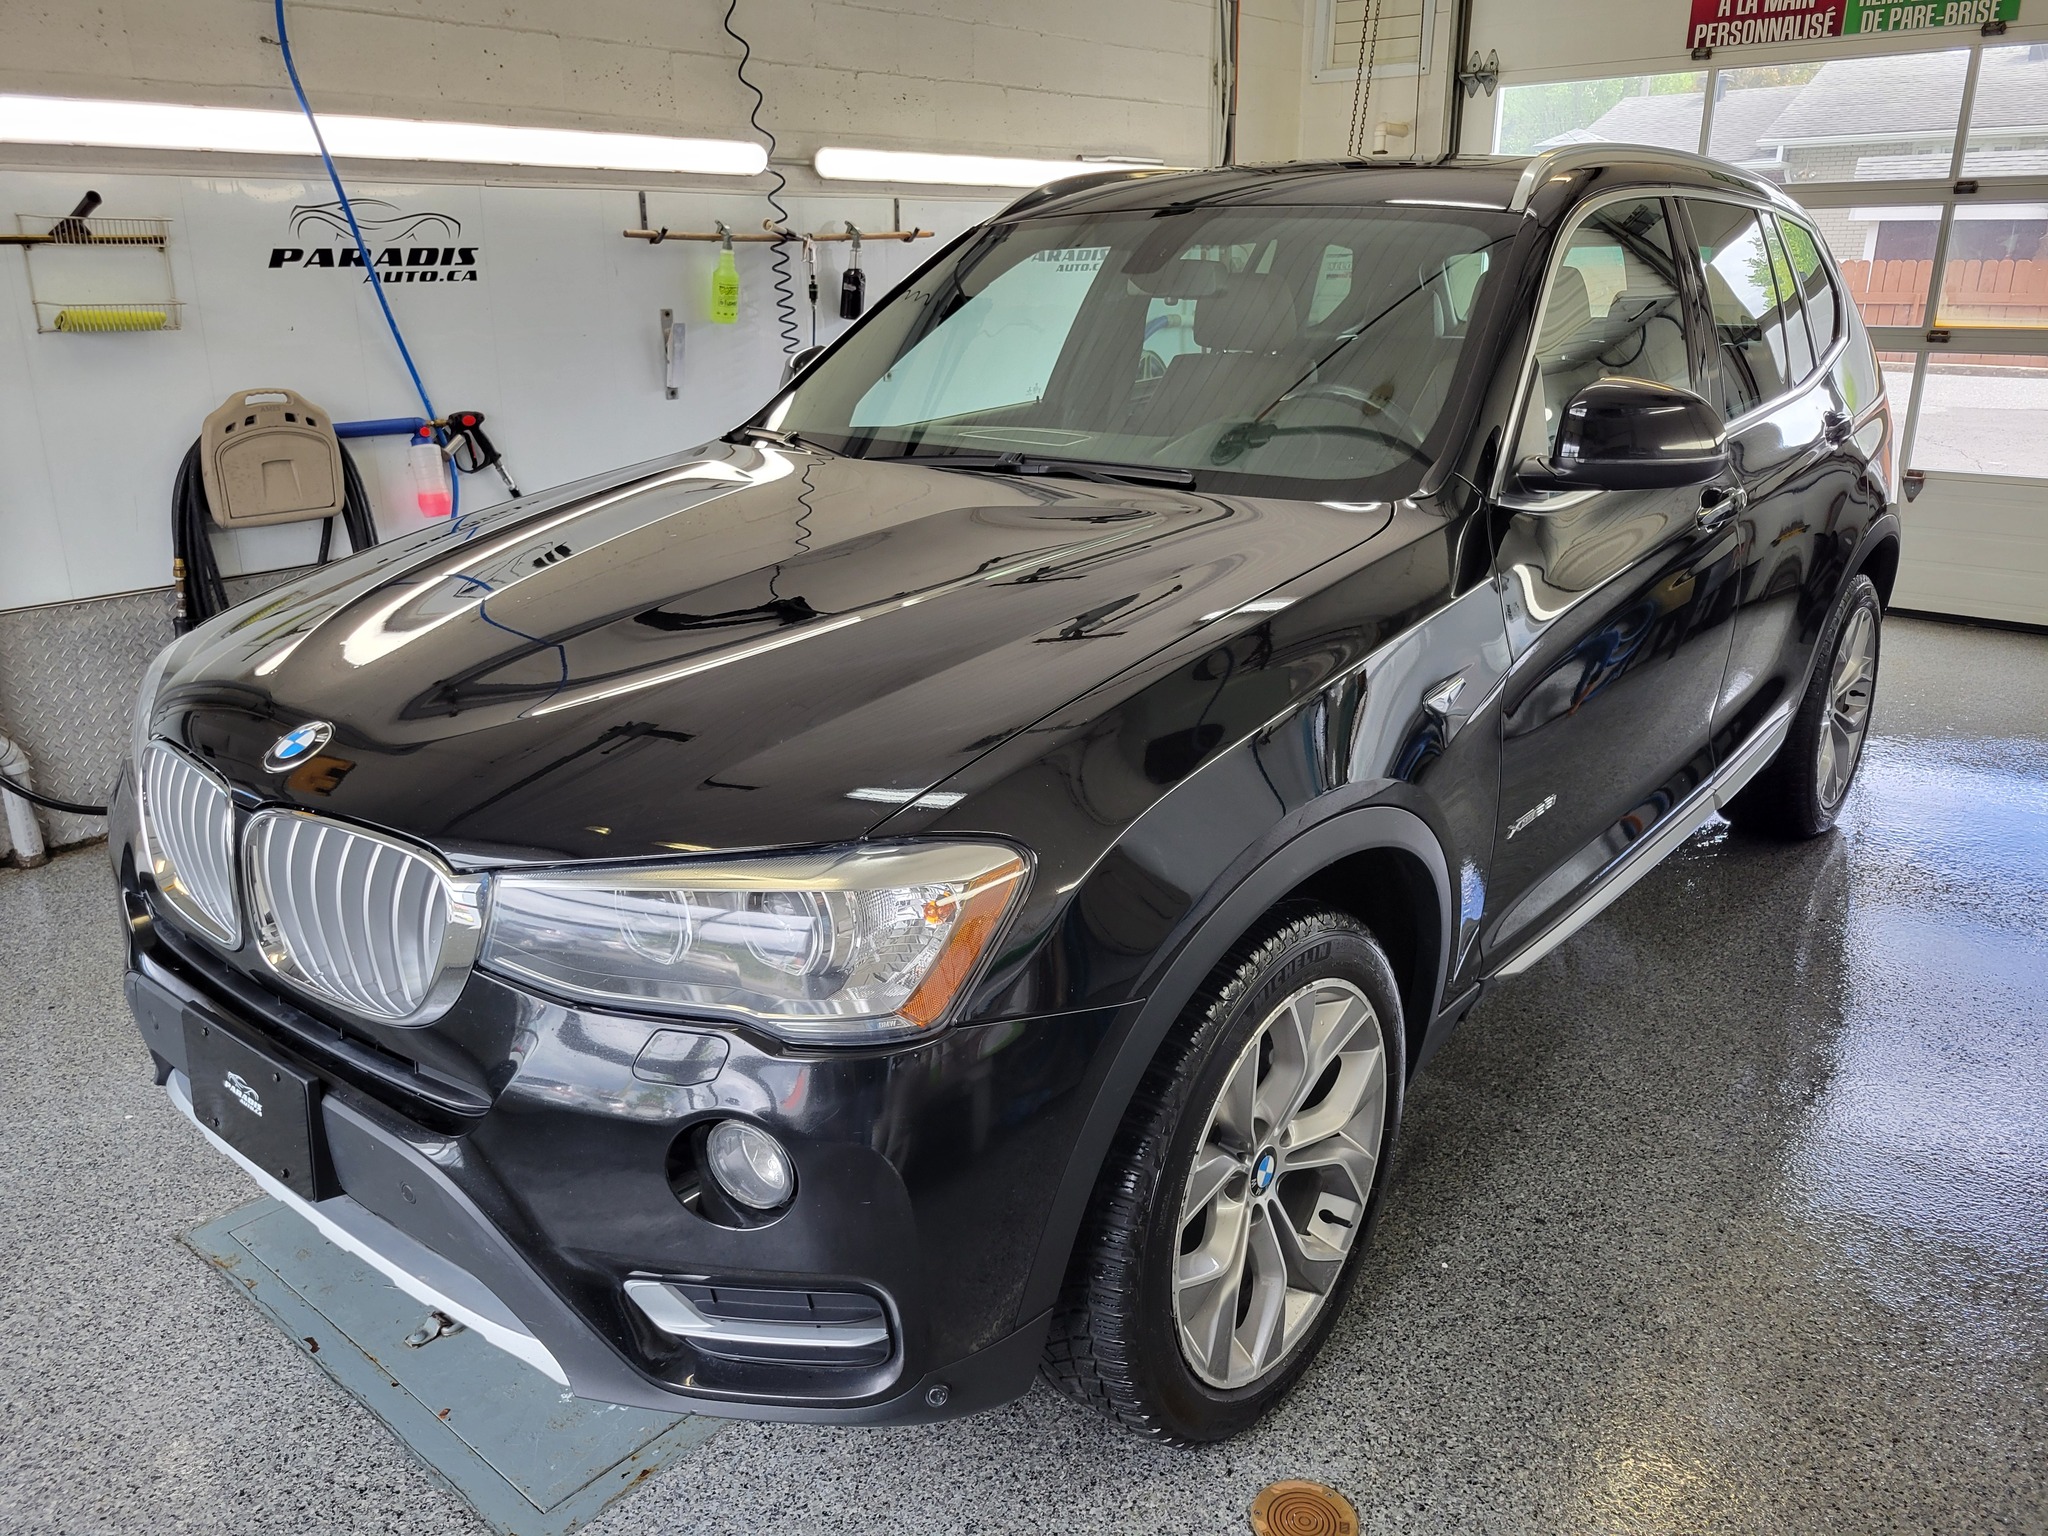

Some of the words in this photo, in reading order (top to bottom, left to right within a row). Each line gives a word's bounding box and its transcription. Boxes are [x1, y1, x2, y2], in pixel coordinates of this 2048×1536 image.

[1693, 5, 1837, 49] PERSONNALISÉ
[1860, 9, 1885, 33] DE
[1888, 0, 2000, 31] PARE-BRISE
[268, 247, 479, 269] PARADIS
[1031, 249, 1109, 262] ARADIS
[363, 270, 478, 284] AUTO.CA
[1056, 263, 1099, 272] AUTO.C
[1253, 941, 1329, 1012] MICHELIN
